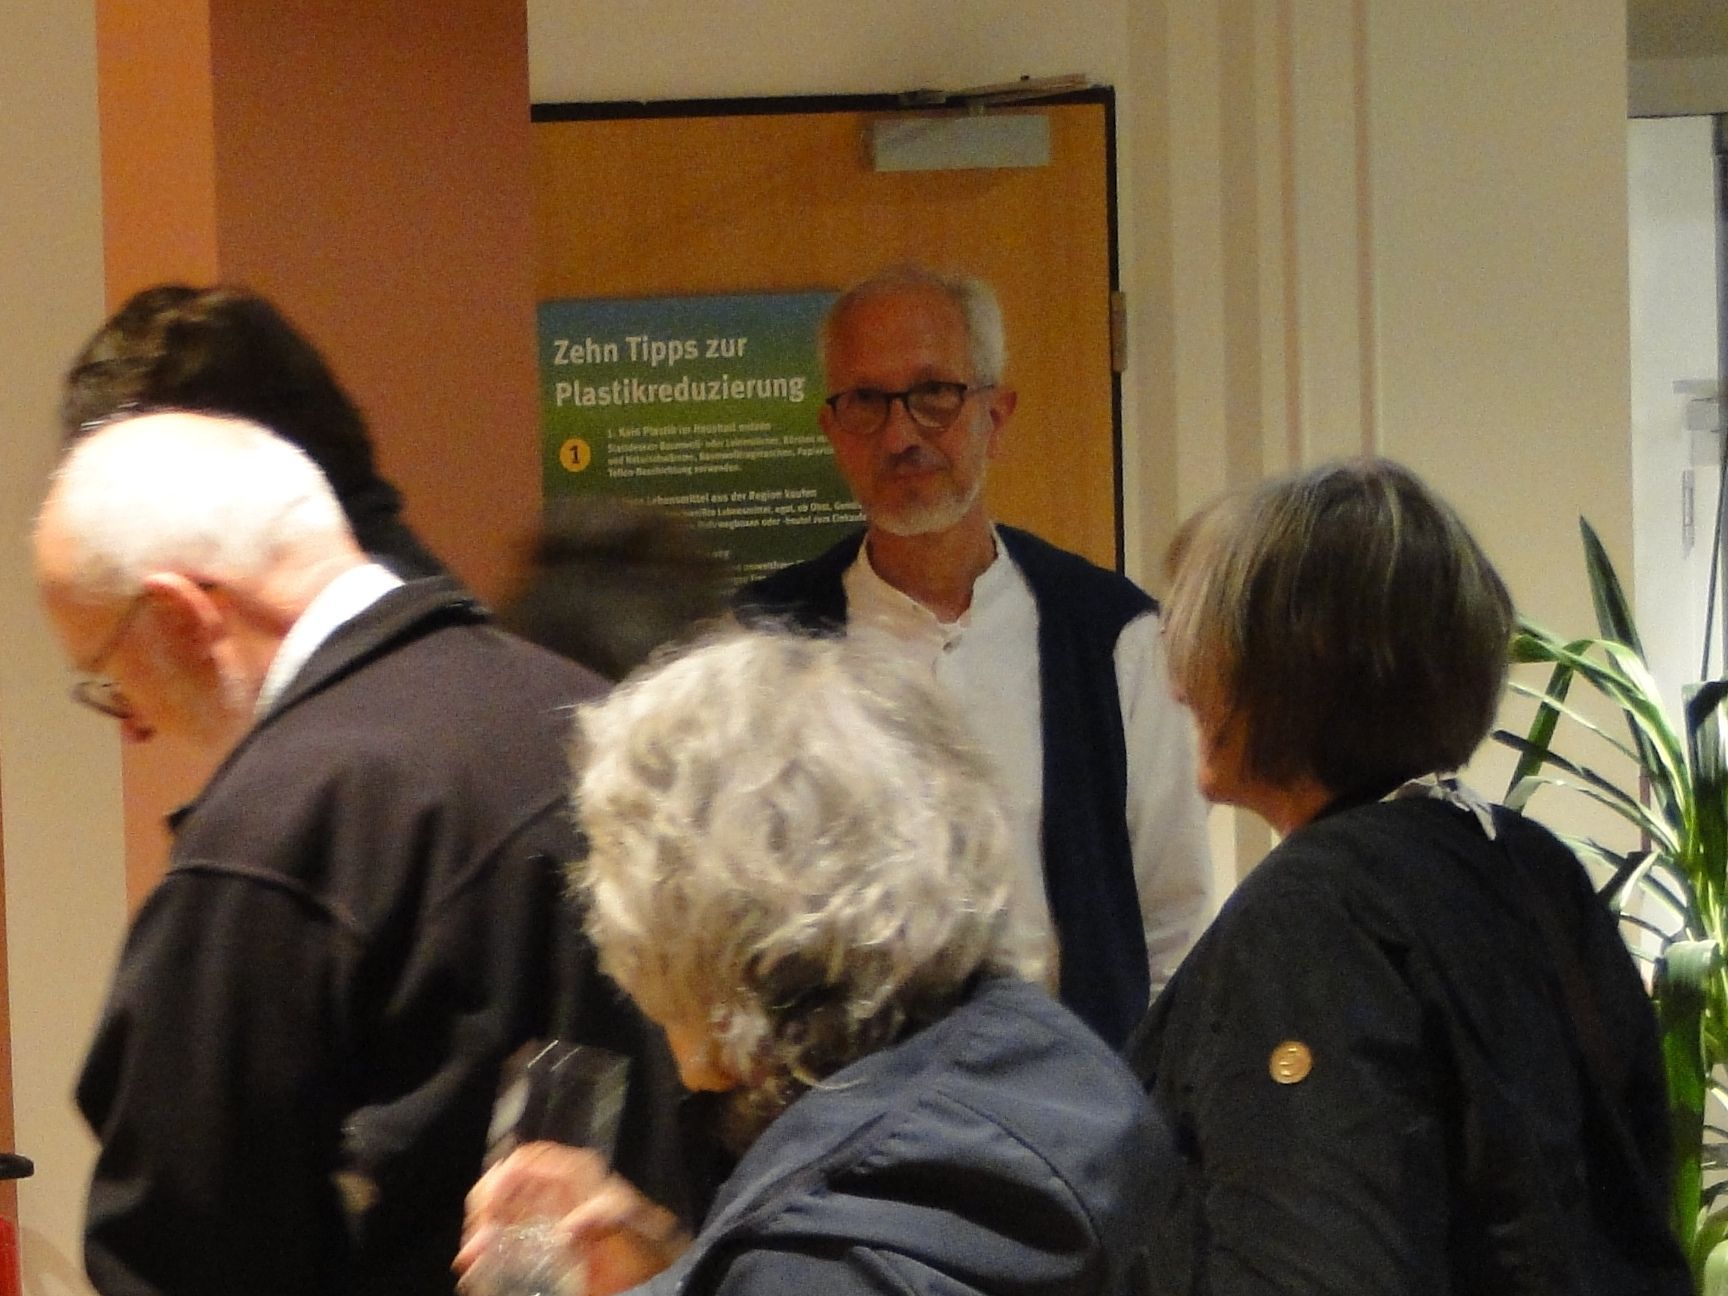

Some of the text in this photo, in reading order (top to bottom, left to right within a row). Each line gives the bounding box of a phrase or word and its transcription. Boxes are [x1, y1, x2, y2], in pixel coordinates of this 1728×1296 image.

[553, 335, 748, 367] Zehn Tipps zur
[555, 374, 806, 407] Plastikreduzierung
[569, 445, 580, 464] 1
